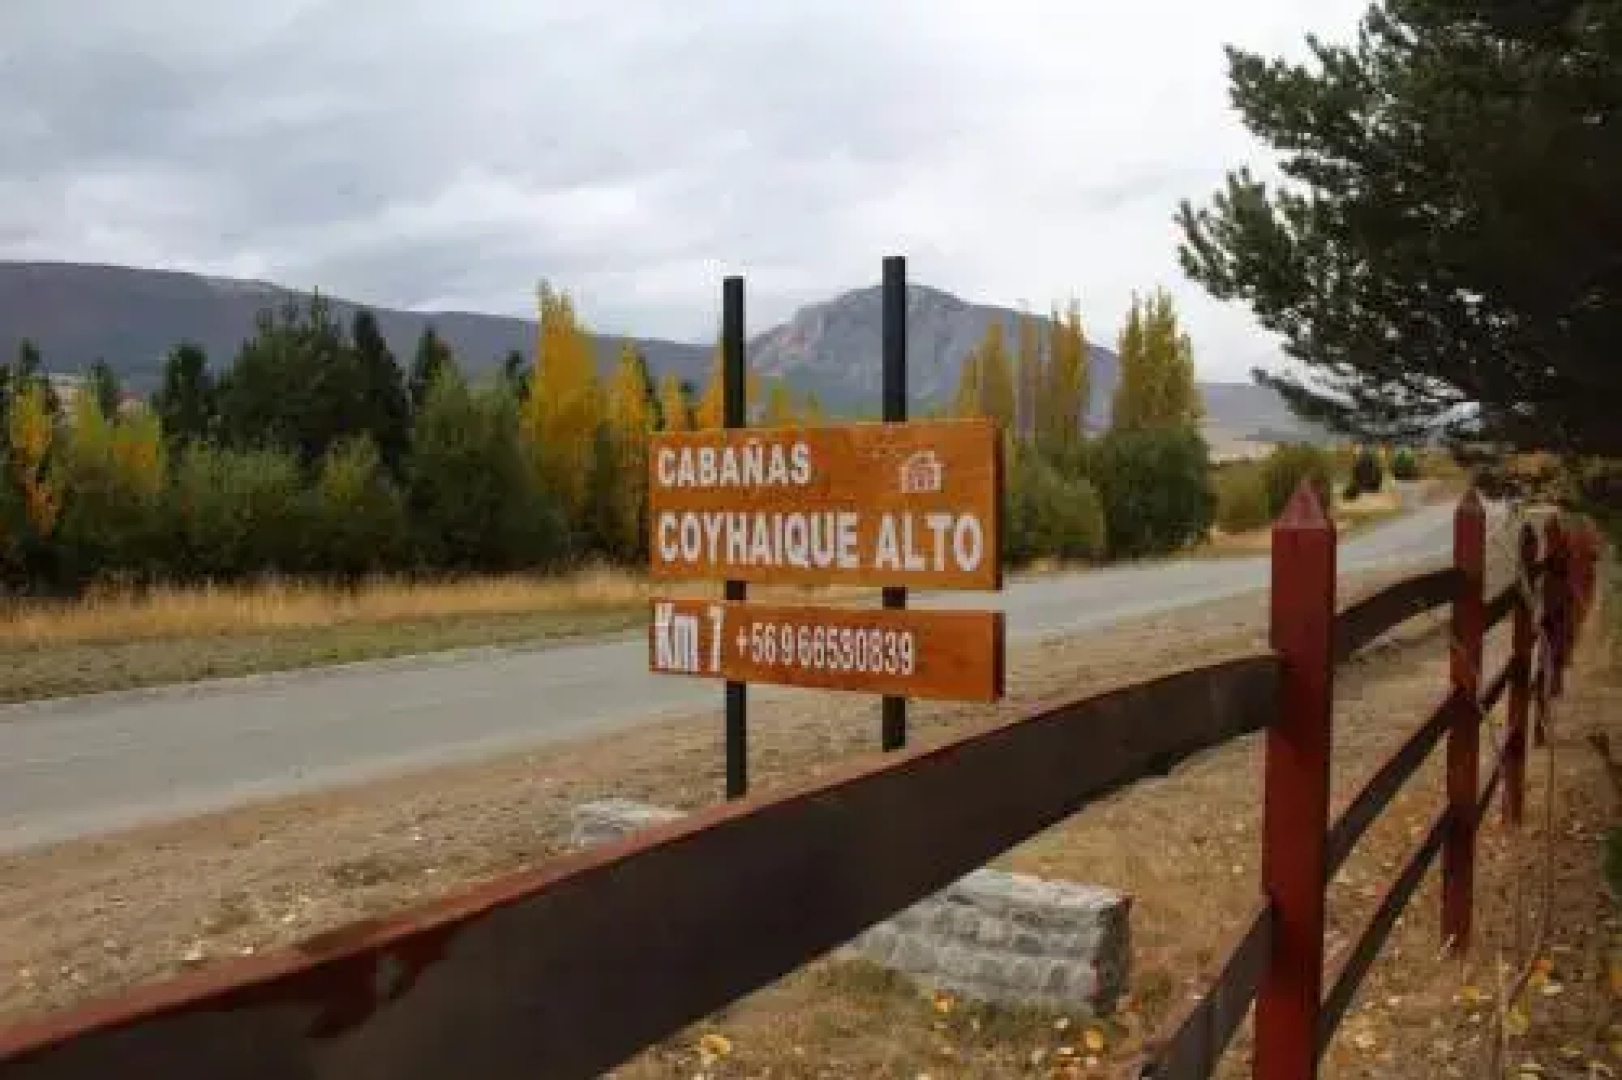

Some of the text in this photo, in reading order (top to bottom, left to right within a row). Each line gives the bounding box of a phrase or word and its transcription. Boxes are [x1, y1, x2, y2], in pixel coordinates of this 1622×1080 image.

[658, 438, 811, 487] CABAÑAS
[658, 512, 984, 571] COYHAIQUE ALTO
[655, 602, 700, 671] Km
